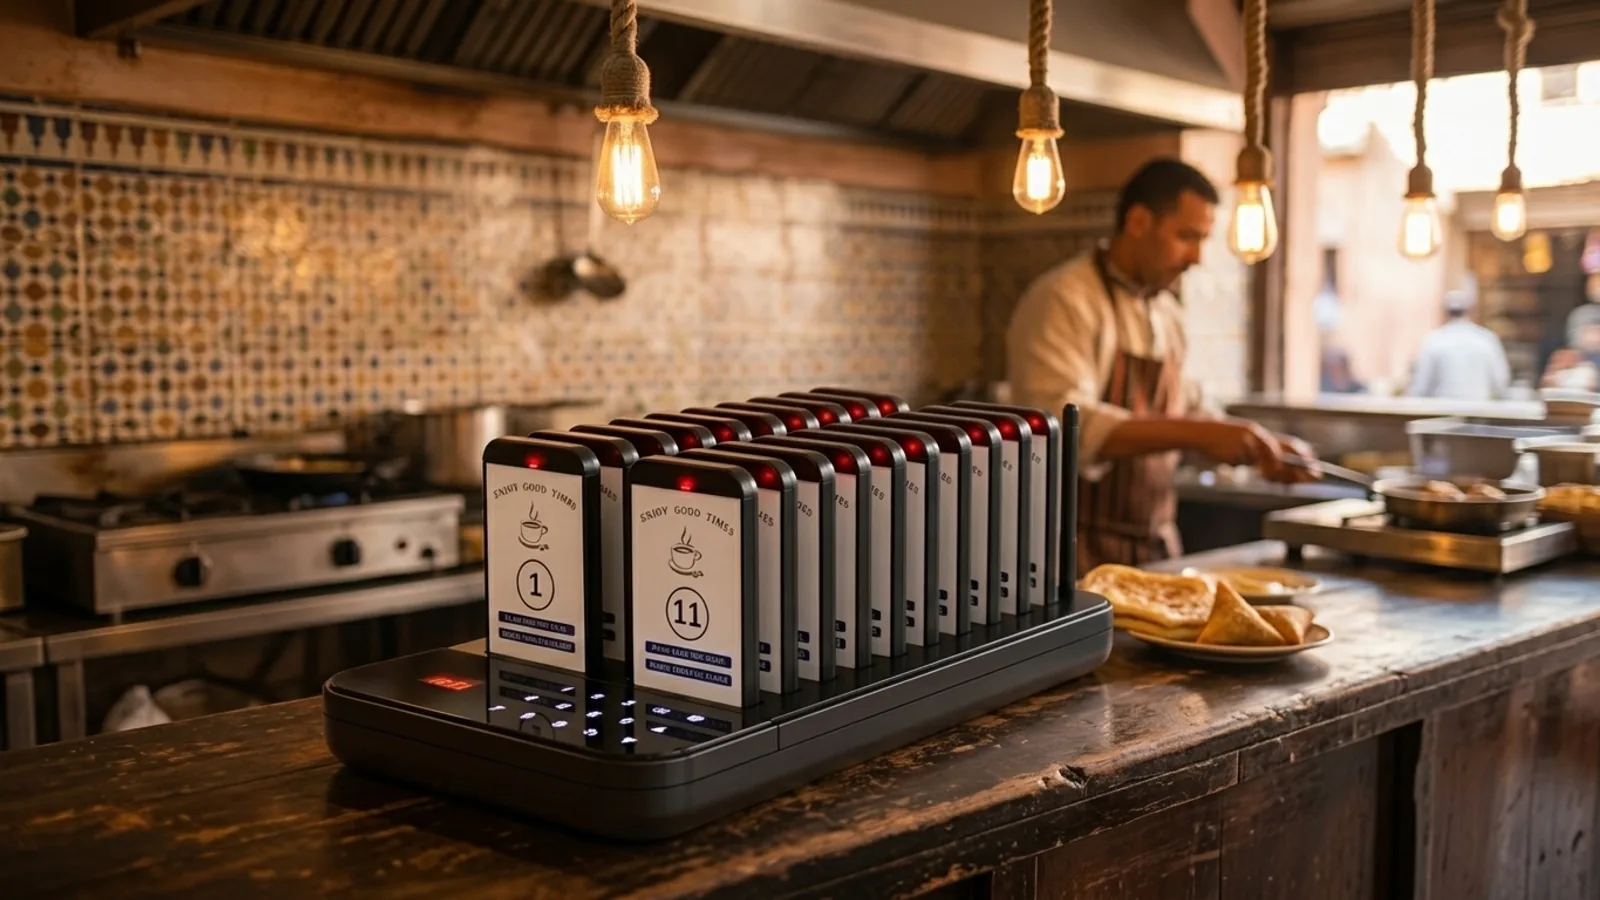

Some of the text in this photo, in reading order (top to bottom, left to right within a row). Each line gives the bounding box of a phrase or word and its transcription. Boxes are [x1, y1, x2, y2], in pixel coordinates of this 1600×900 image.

[522, 482, 547, 494] GOOD
[529, 572, 543, 597] 1
[673, 599, 702, 628] 11
